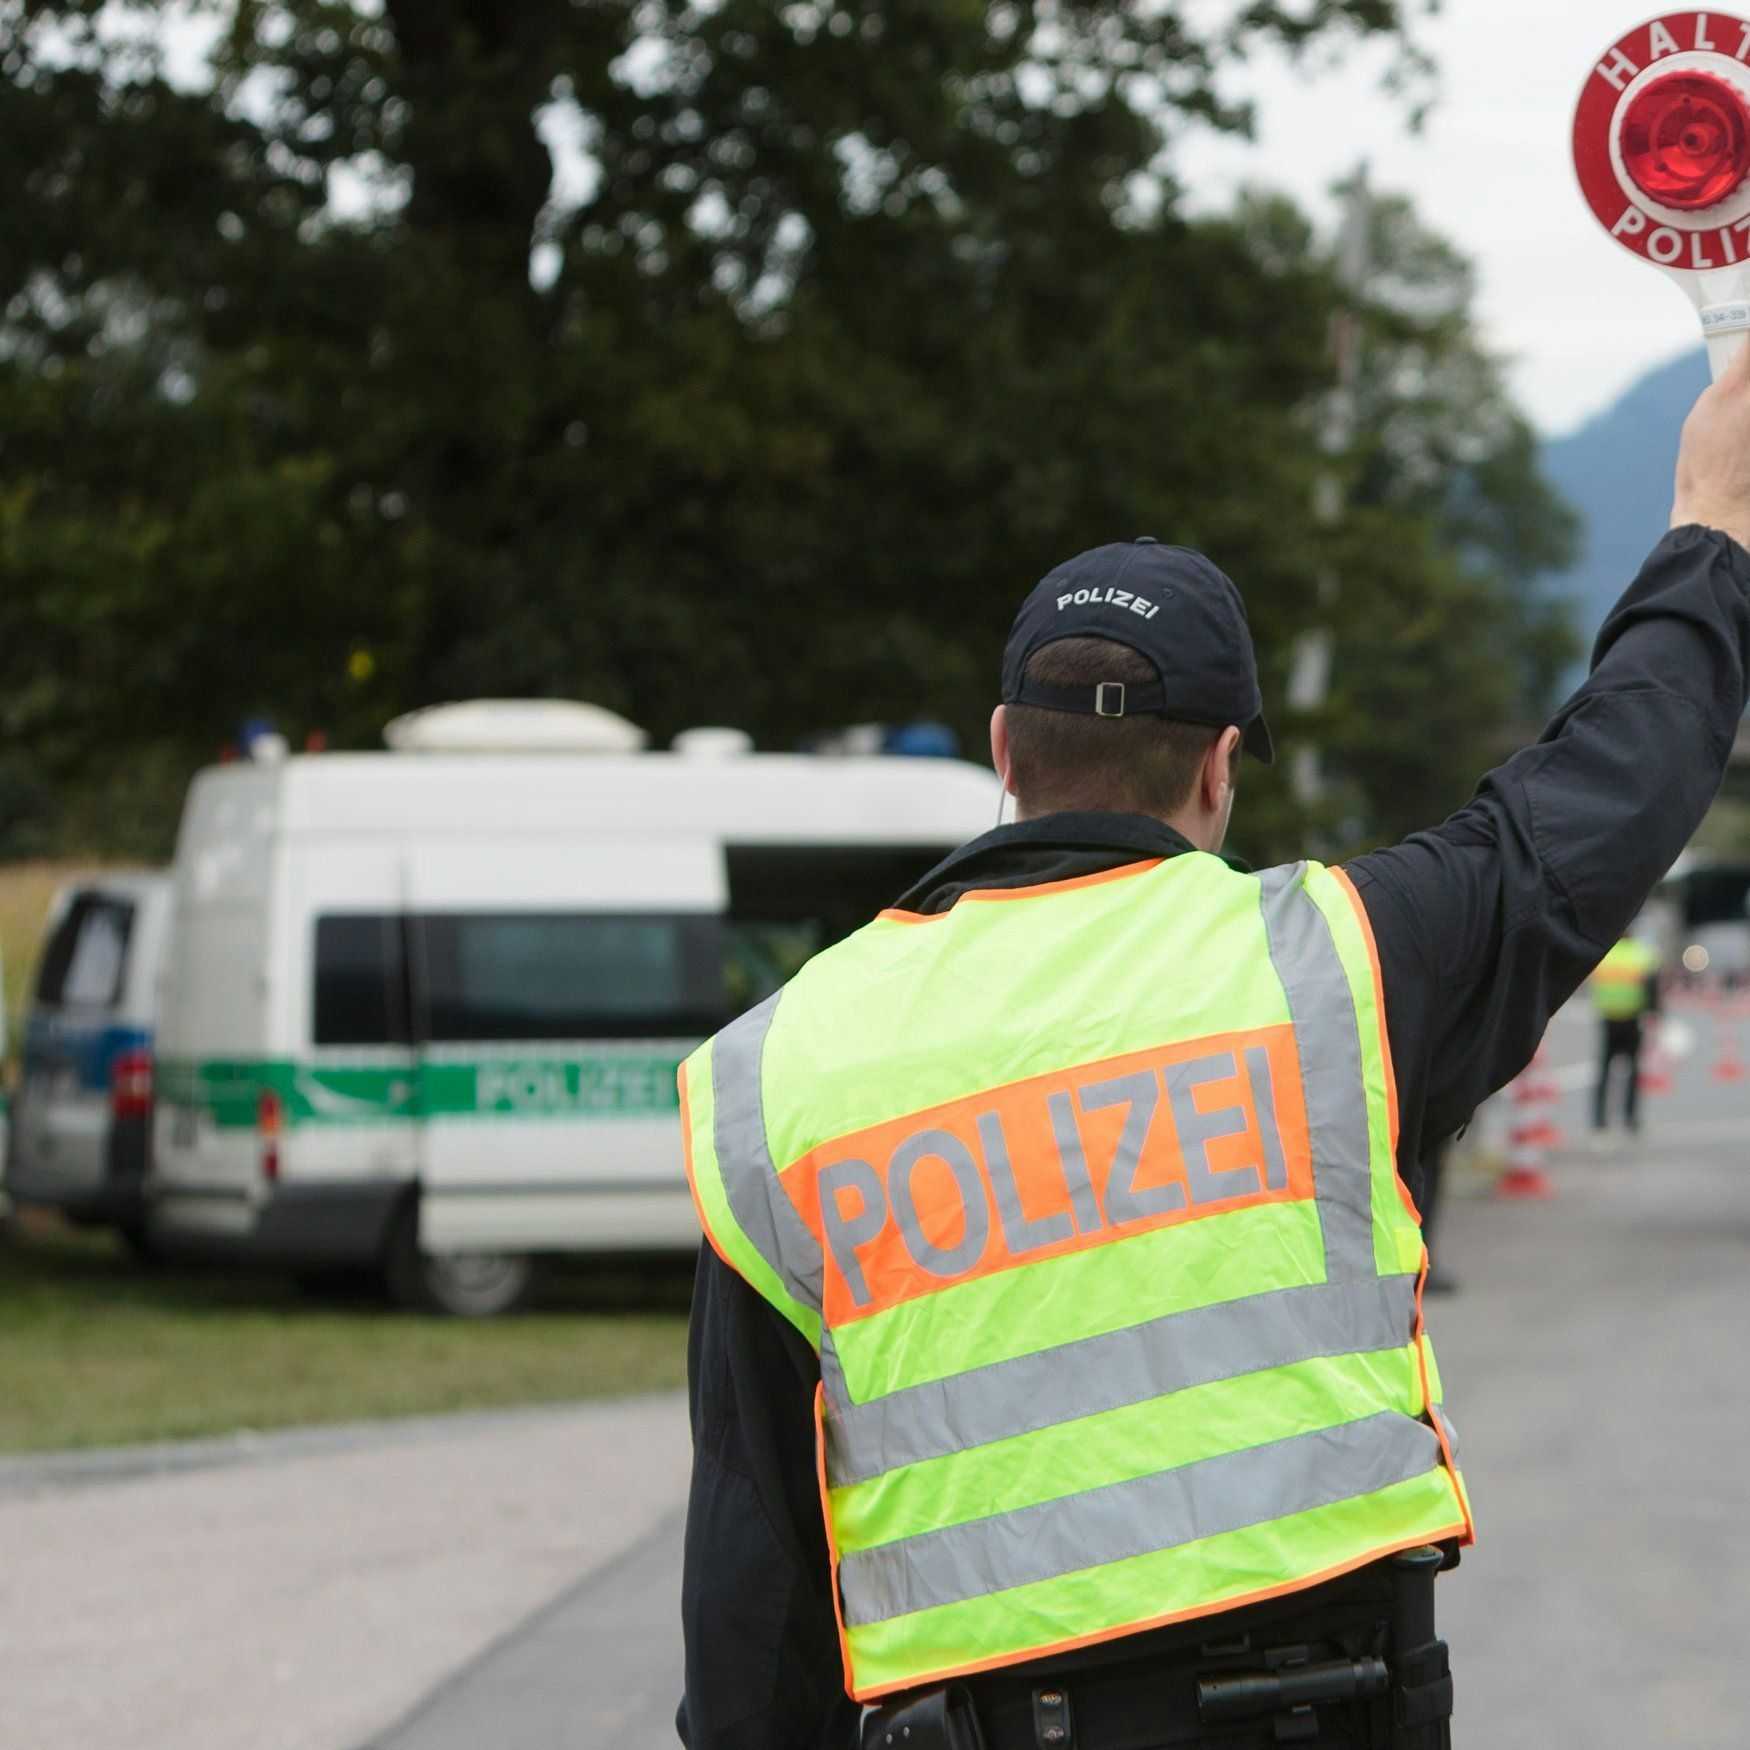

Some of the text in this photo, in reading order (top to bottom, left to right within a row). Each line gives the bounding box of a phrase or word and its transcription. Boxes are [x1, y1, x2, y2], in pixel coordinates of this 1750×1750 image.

[1056, 587, 1160, 620] POLIZEI
[477, 1061, 674, 1111] POLIZEI
[817, 1045, 1289, 1308] POLIZEI
